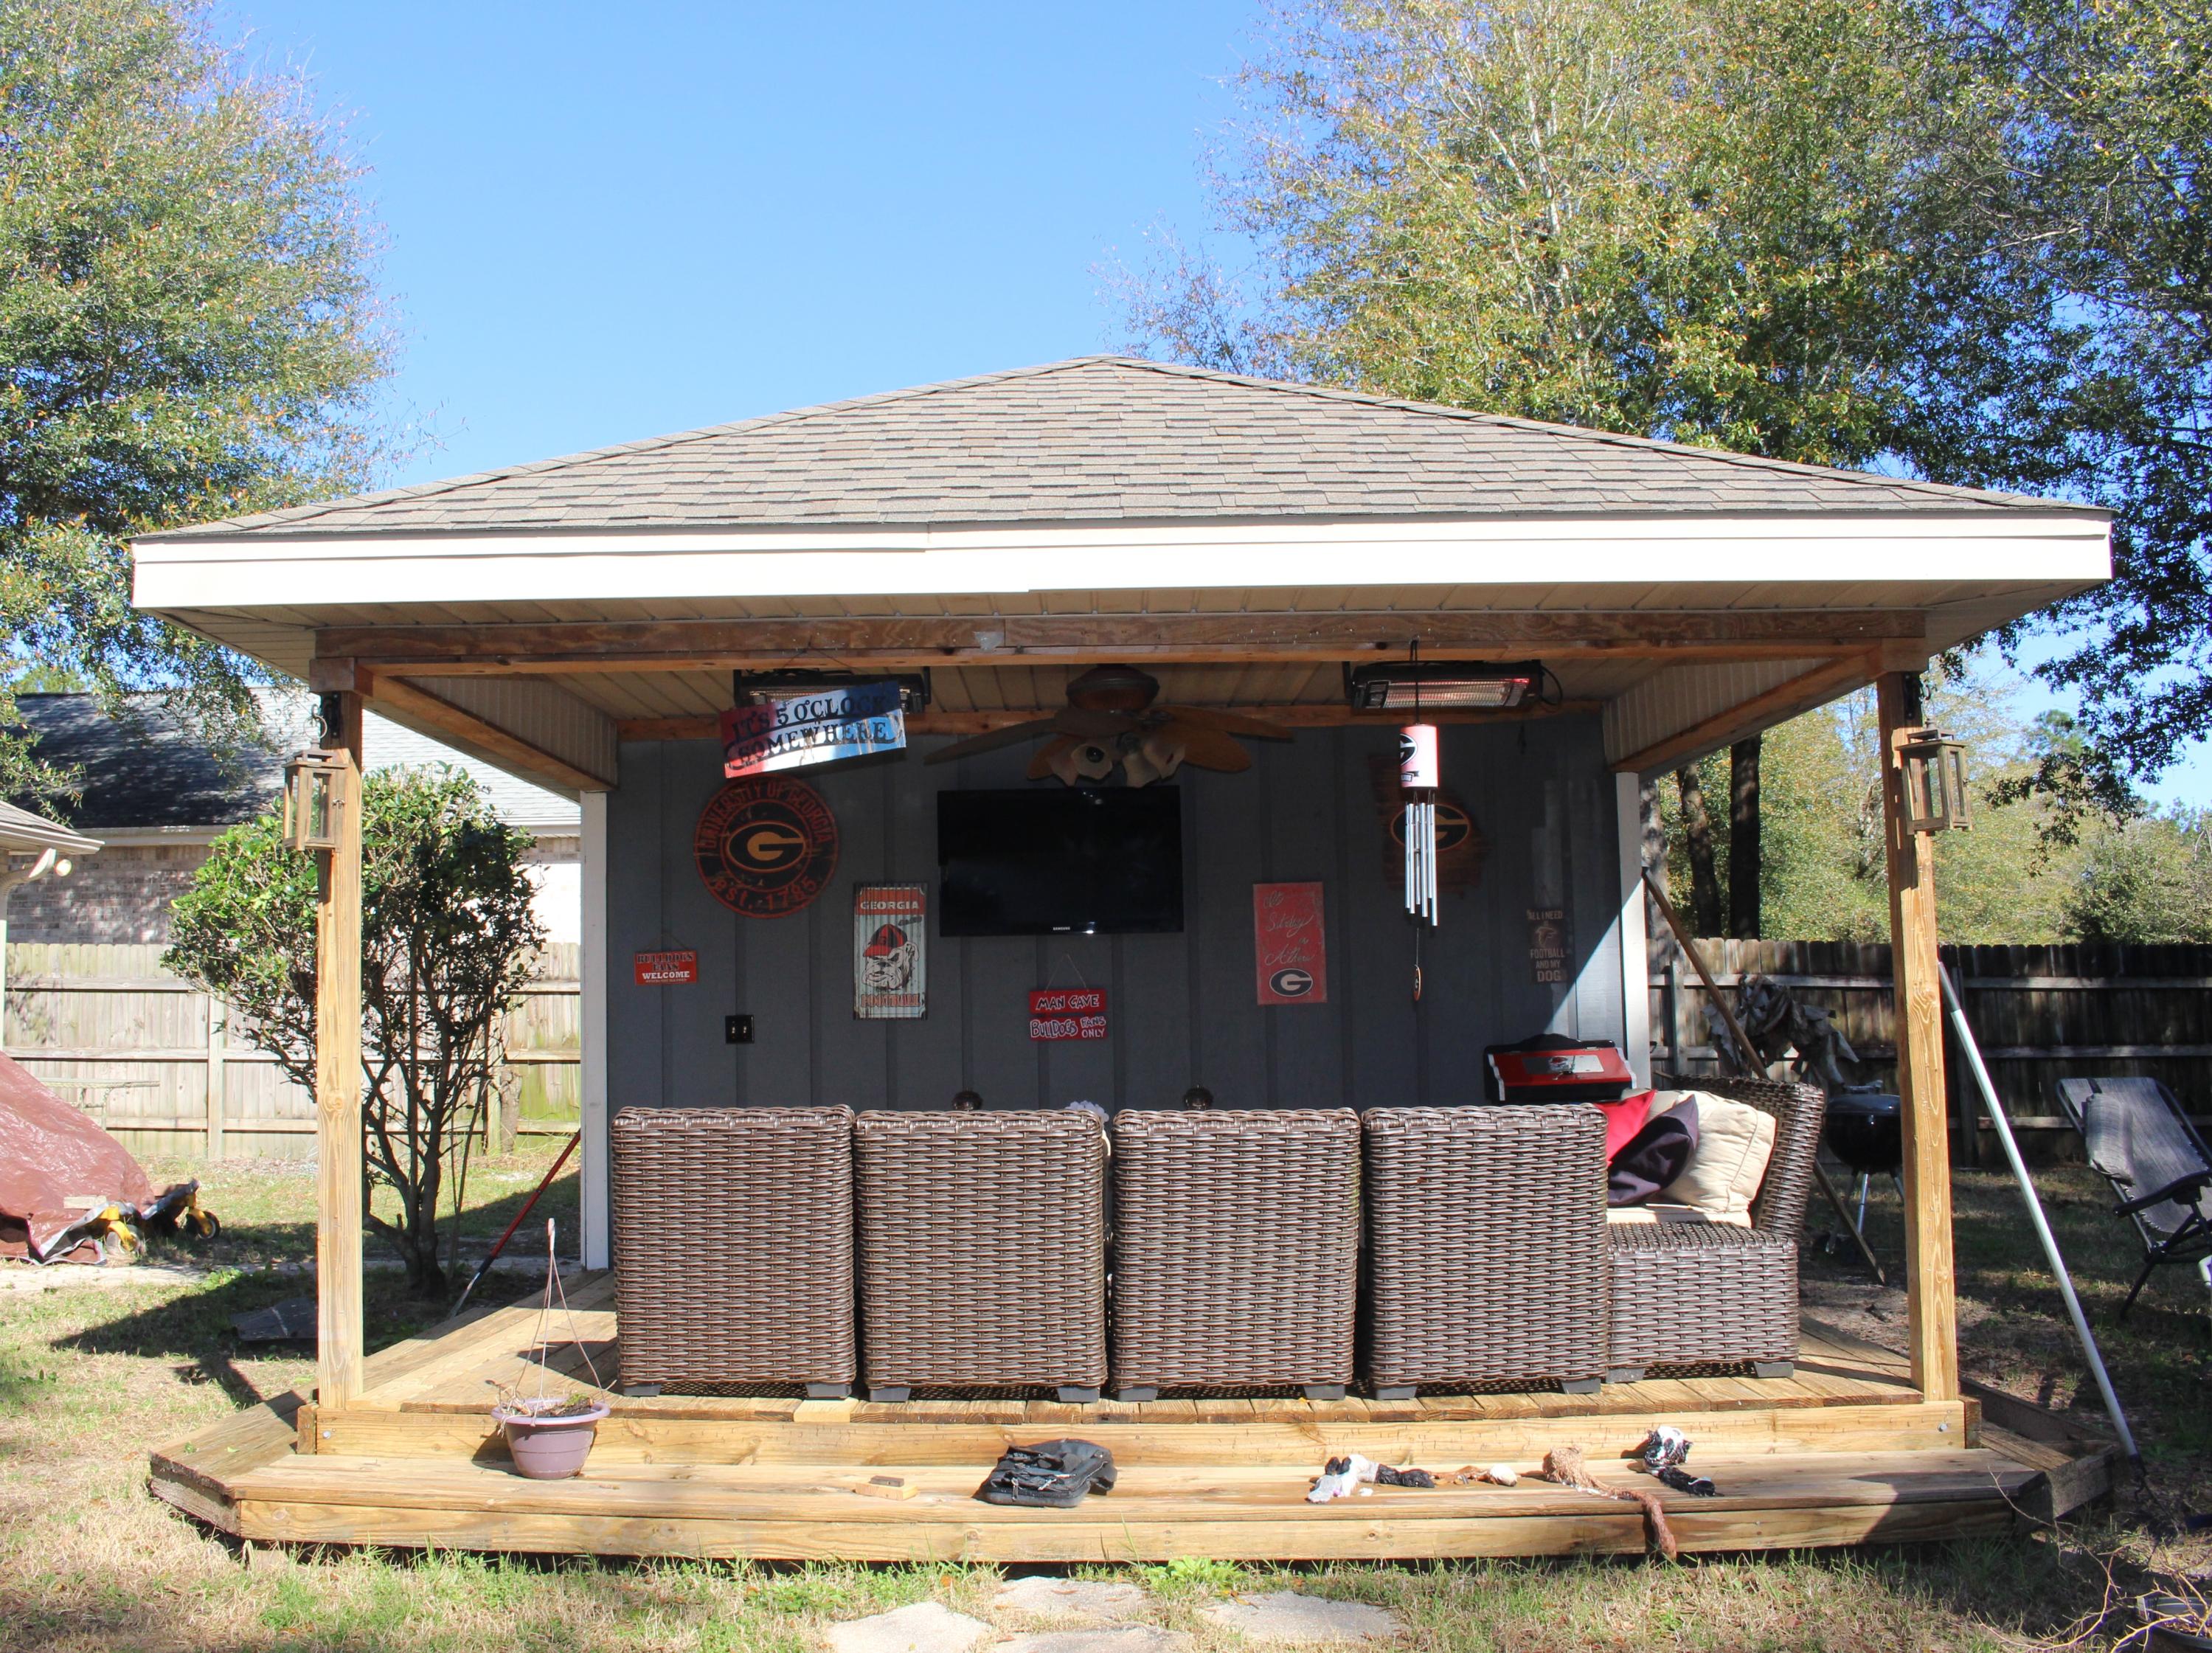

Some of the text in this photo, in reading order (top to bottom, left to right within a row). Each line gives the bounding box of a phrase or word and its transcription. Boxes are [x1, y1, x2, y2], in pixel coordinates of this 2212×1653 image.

[732, 710, 771, 740] IT'S
[776, 709, 789, 725] 5
[738, 721, 887, 758] SOMEWHERE
[698, 781, 833, 850] UNIVERSITY OF GEORGIA
[766, 876, 817, 911] 1785
[860, 901, 920, 910] GEORGIA
[1544, 910, 1564, 921] NEED
[1530, 948, 1565, 959] FOOTBALL
[1536, 960, 1561, 968] AND MY
[642, 971, 690, 980] WELCOME
[1536, 970, 1561, 983] DOG
[1035, 994, 1099, 1011] MAN CAVE
[1080, 1016, 1106, 1028] FANS
[1030, 1019, 1078, 1039] BULLDOGS
[1081, 1028, 1106, 1038] ONLY
